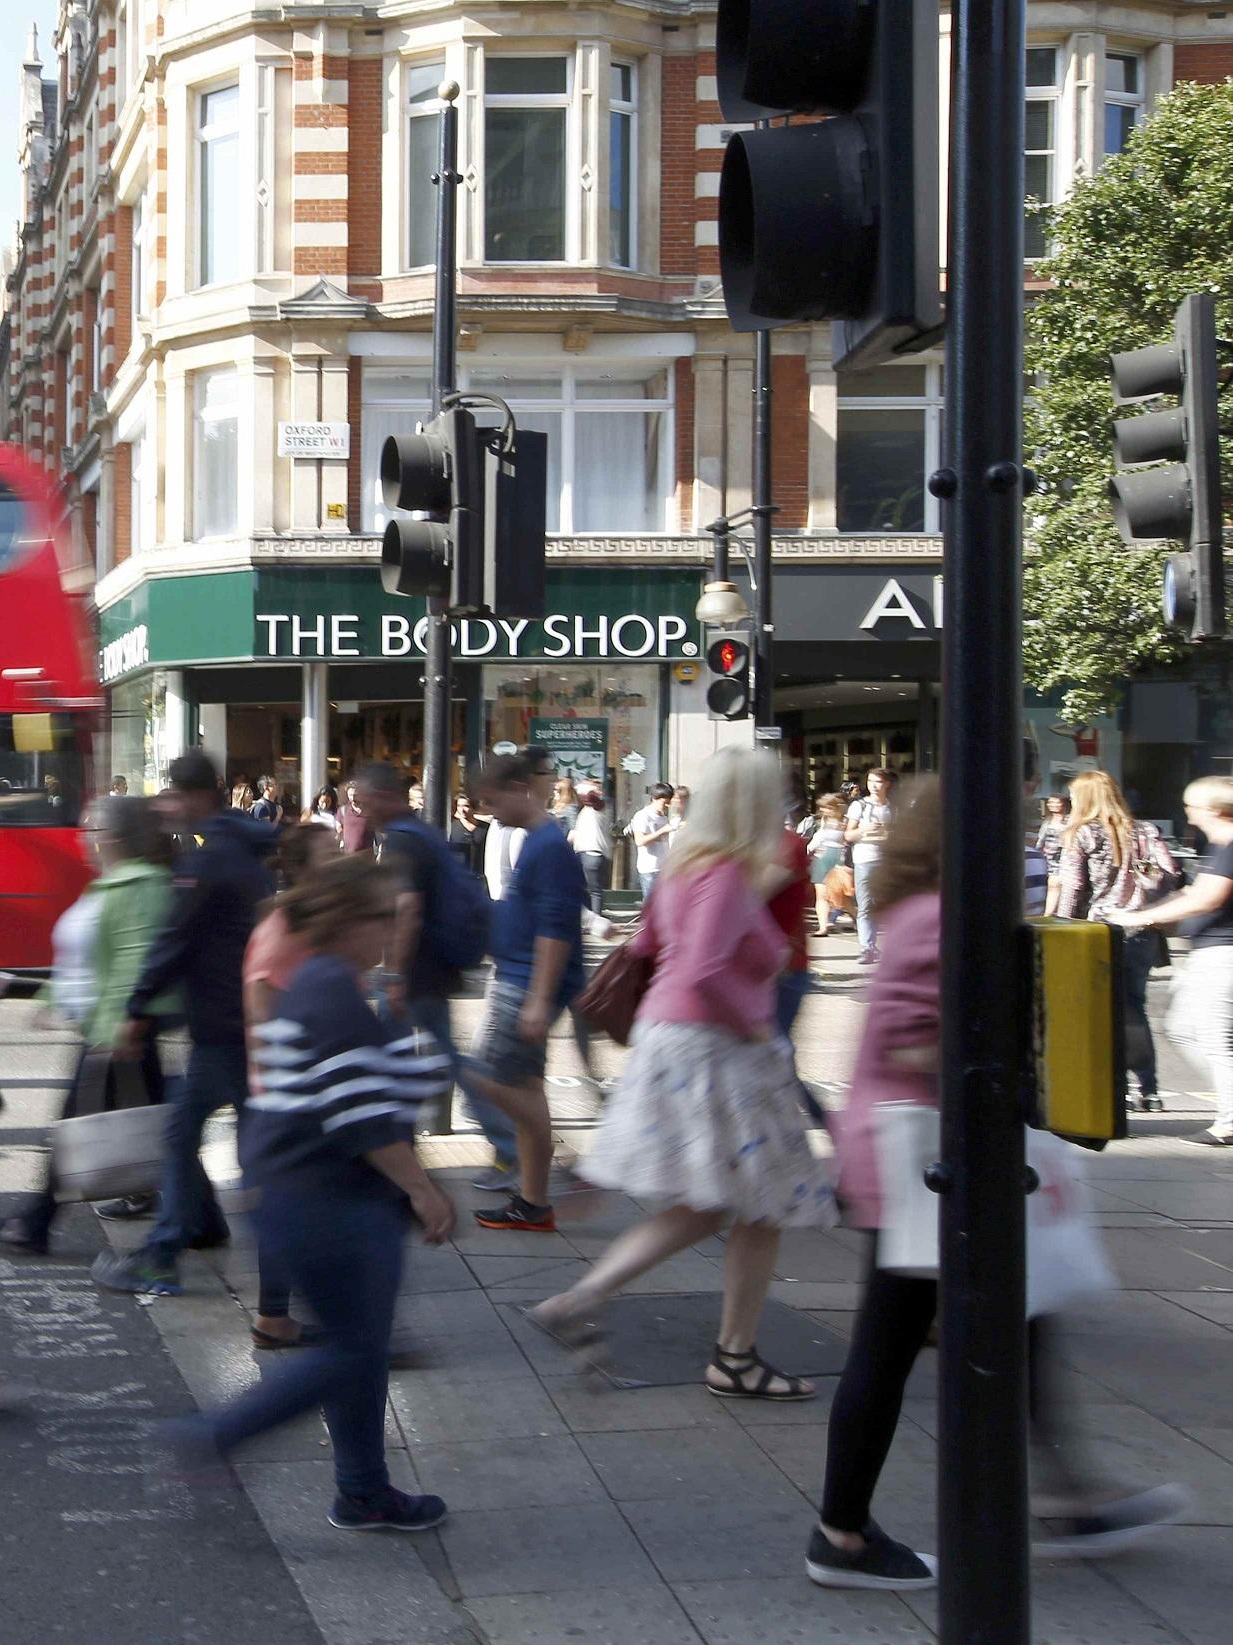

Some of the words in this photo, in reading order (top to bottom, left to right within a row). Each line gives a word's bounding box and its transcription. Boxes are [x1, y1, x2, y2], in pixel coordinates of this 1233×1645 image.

[284, 425, 331, 435] OXFORD
[284, 436, 326, 447] STREET
[256, 614, 360, 656] THE
[381, 614, 530, 656] BODY
[535, 729, 603, 739] SUPERHEROES
